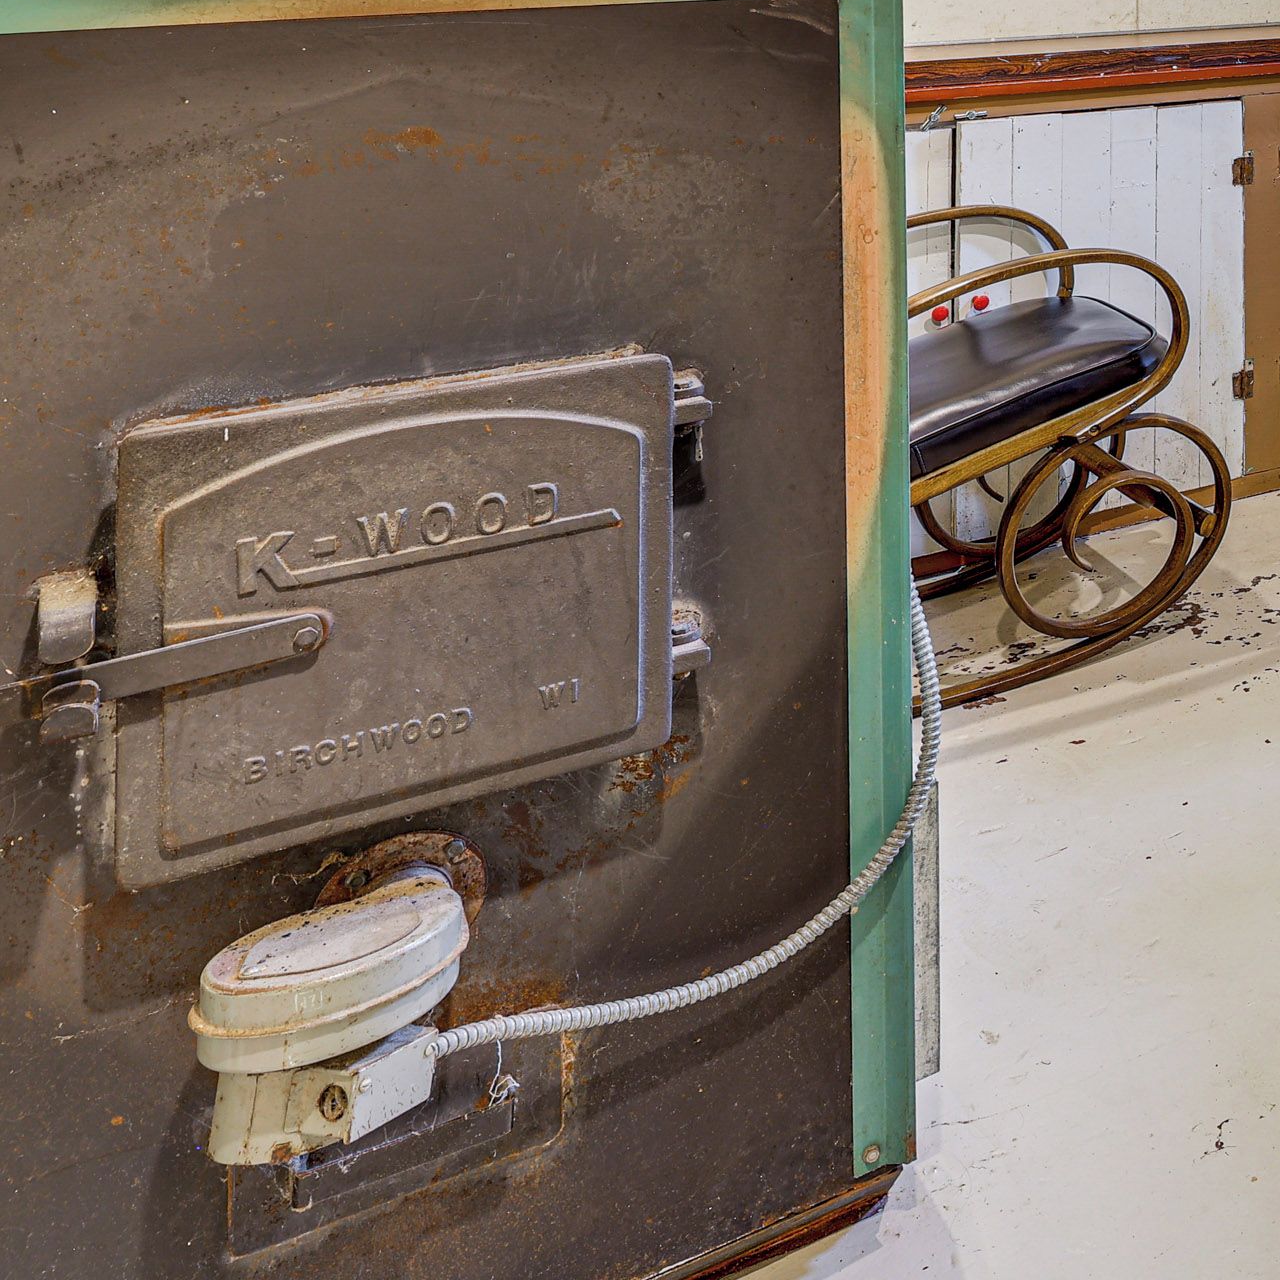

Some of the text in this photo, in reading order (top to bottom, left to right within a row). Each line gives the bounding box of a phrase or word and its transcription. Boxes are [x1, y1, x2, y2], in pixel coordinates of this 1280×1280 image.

[235, 481, 559, 598] K-WOOD
[243, 677, 581, 785] BIRCHWOOD WI
